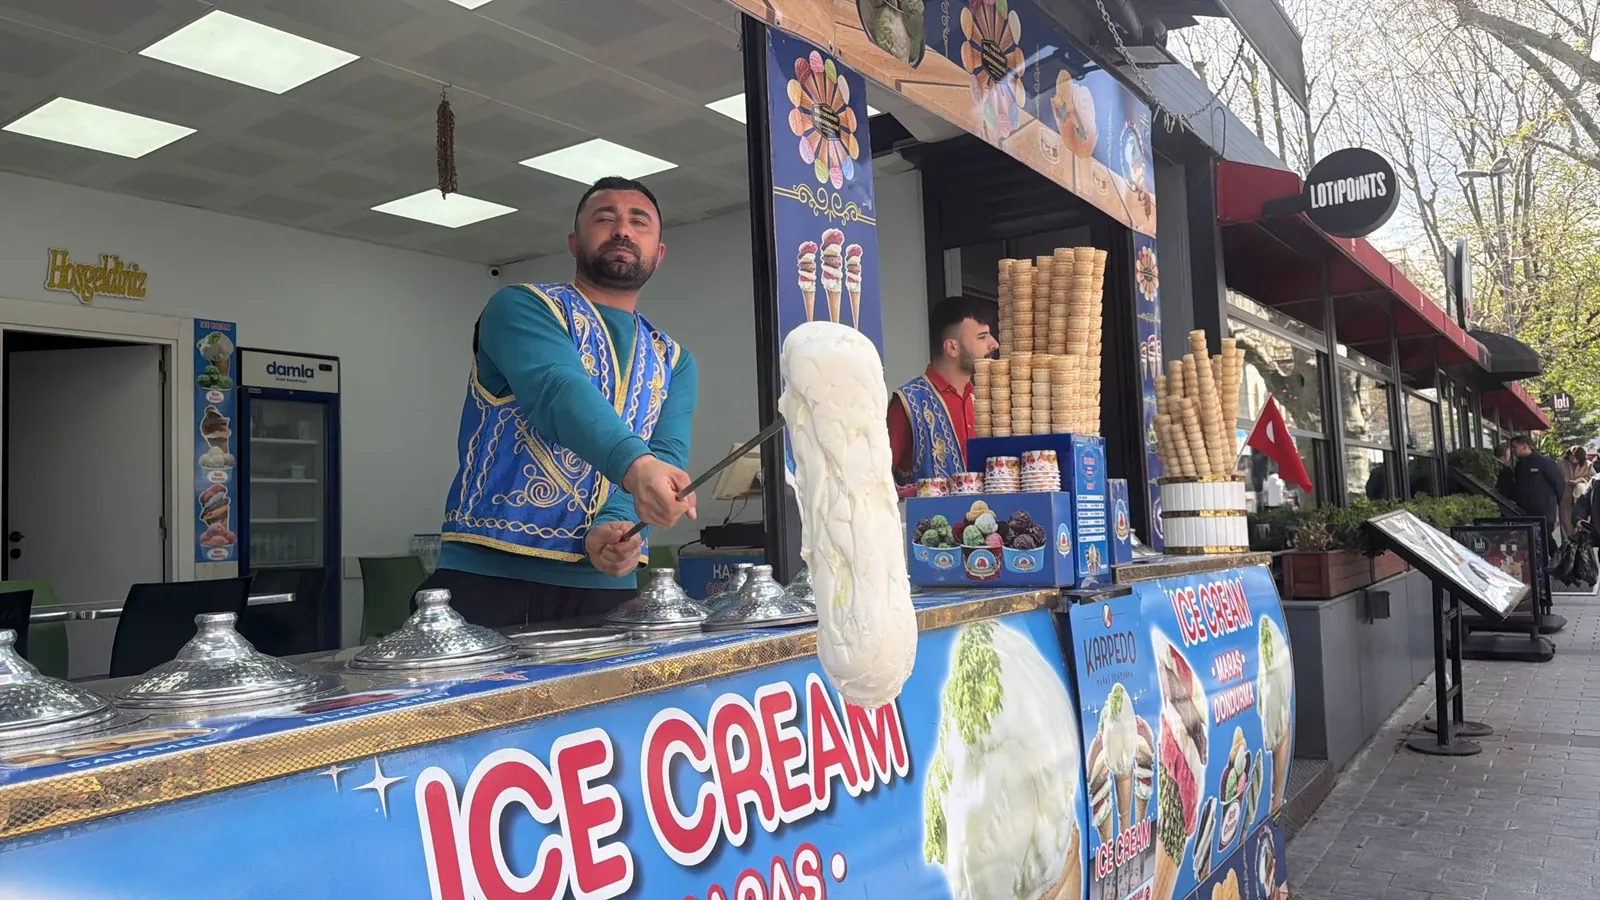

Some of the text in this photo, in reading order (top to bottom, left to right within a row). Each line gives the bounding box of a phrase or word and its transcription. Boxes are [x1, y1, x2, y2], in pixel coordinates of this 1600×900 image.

[266, 361, 315, 379] damla
[1170, 577, 1254, 648] ICE CREAM
[1083, 630, 1137, 679] KARPEDO
[1213, 648, 1244, 684] MARAŞ
[305, 692, 451, 722] BLACKBERRY
[1213, 681, 1255, 726] DONDURMA
[68, 738, 218, 768] CARAMEL
[416, 672, 910, 900] ICE CREAM
[1095, 816, 1152, 882] ICE CREAM
